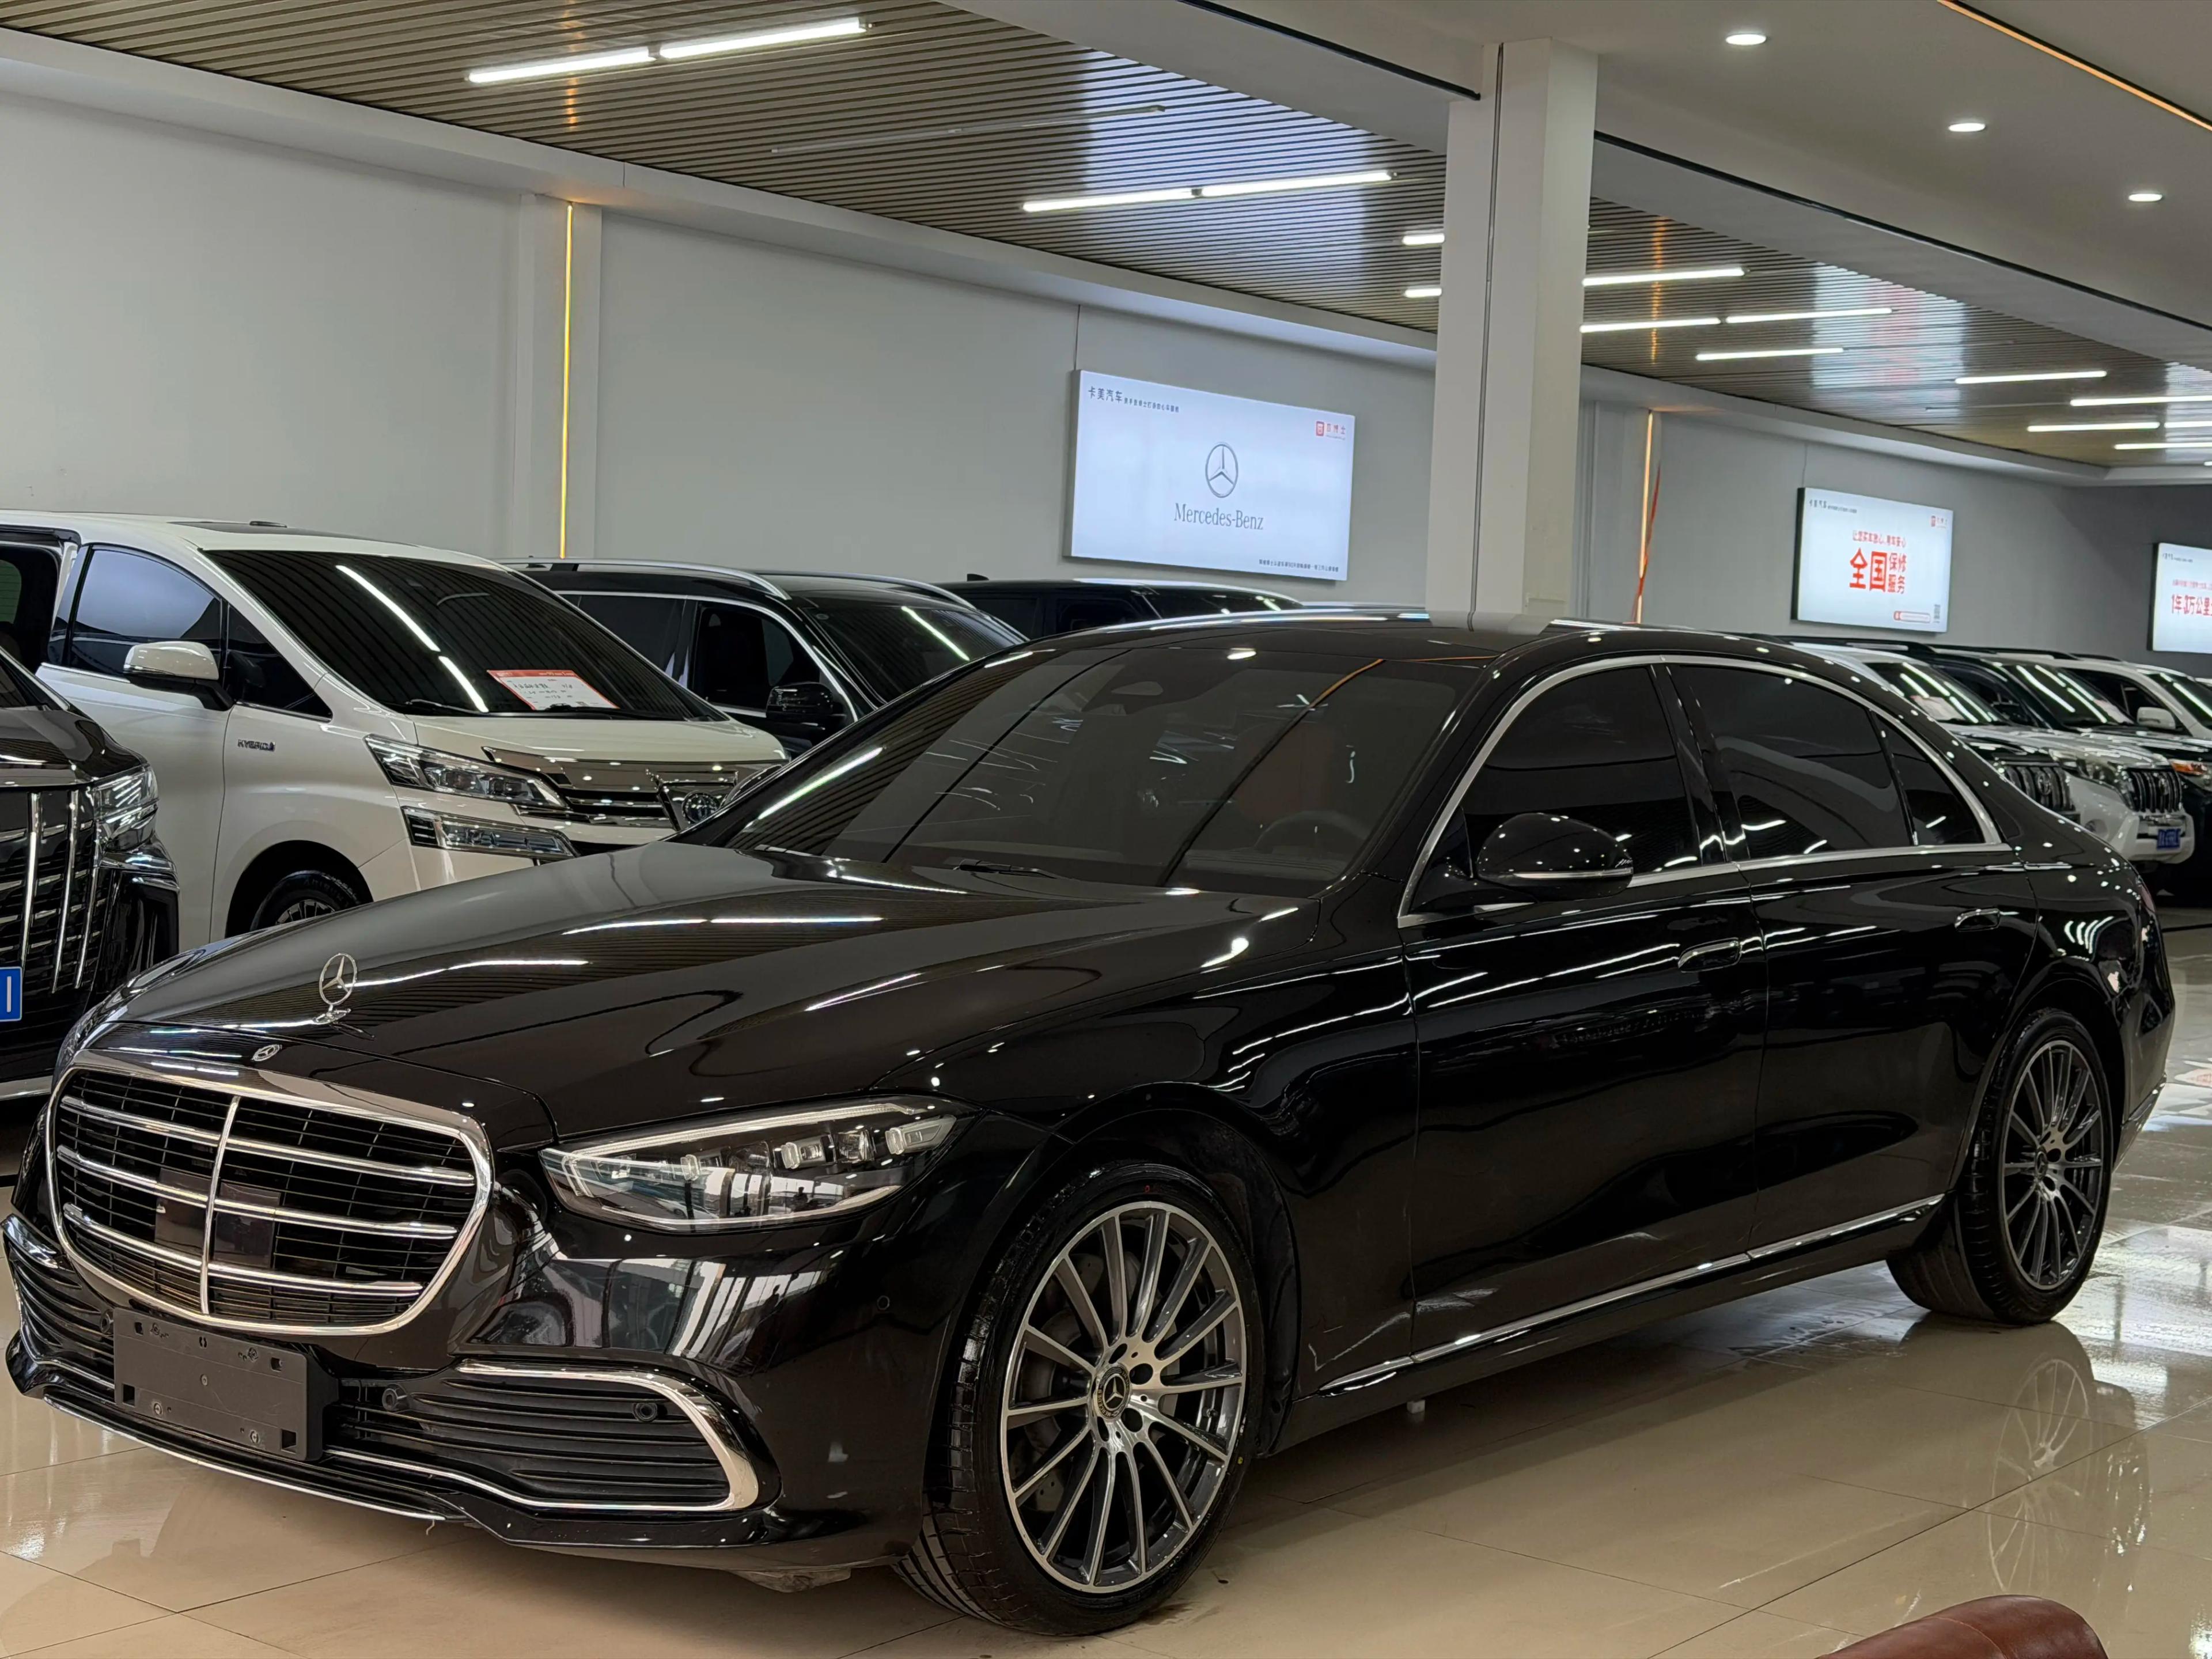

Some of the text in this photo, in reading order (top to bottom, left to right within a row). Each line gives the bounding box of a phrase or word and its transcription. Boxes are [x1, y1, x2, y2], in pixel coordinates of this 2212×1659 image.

[1088, 386, 1123, 403] 卡美汽车
[1174, 502, 1264, 531] Mercedes-Benz
[1849, 548, 1888, 592] 全国
[1889, 552, 1907, 573] 保修
